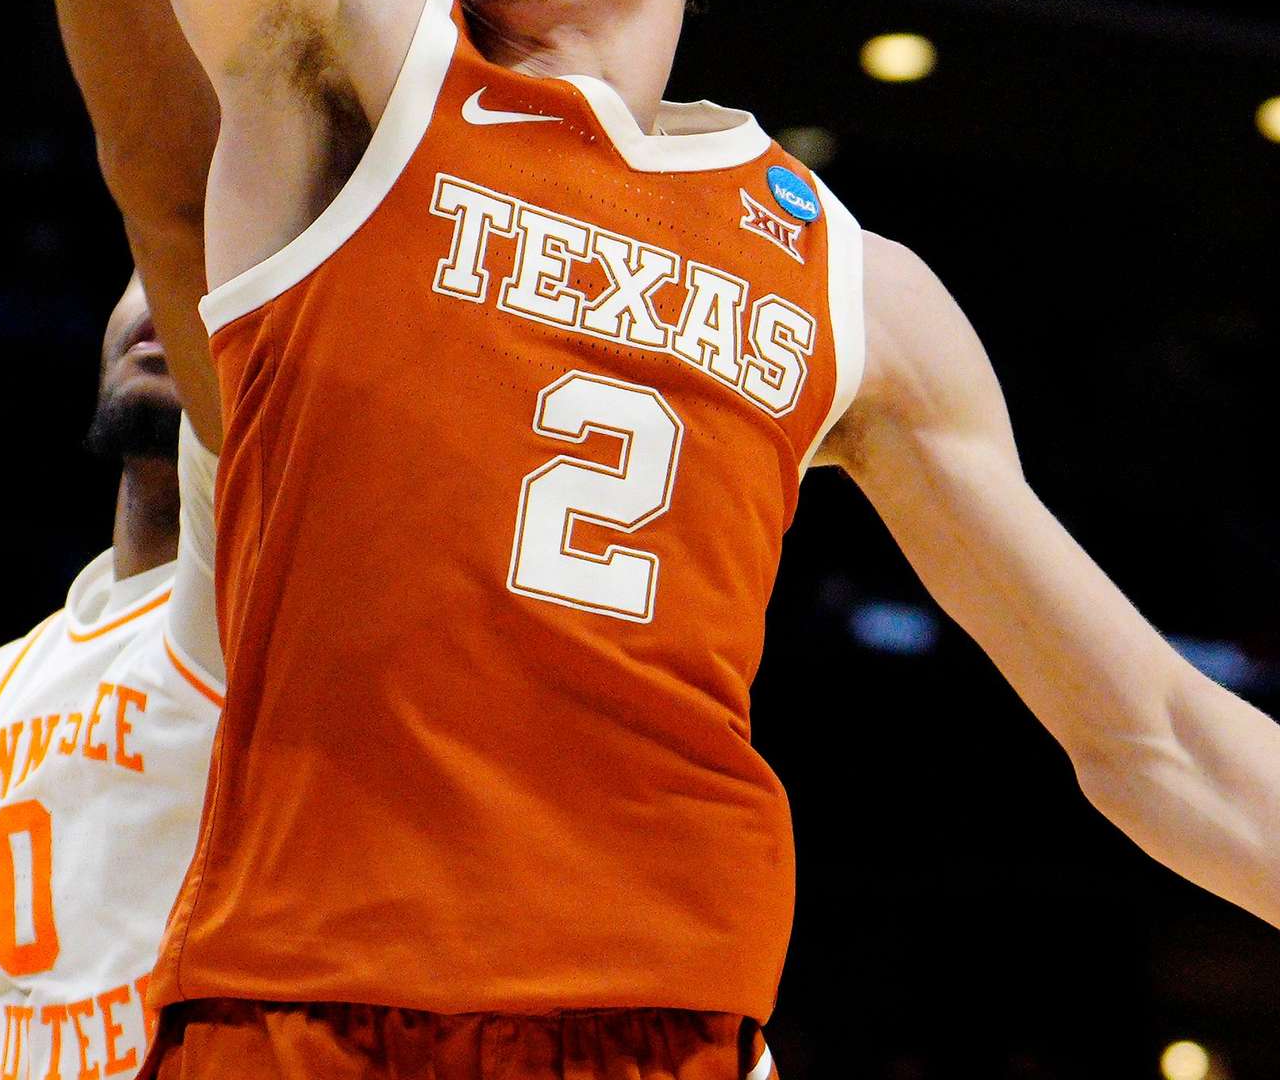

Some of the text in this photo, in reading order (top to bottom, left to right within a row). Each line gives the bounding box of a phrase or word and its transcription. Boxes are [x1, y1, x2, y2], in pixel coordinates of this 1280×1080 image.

[429, 172, 817, 418] TEXAS
[774, 183, 817, 215] NCAA
[506, 369, 684, 624] 2
